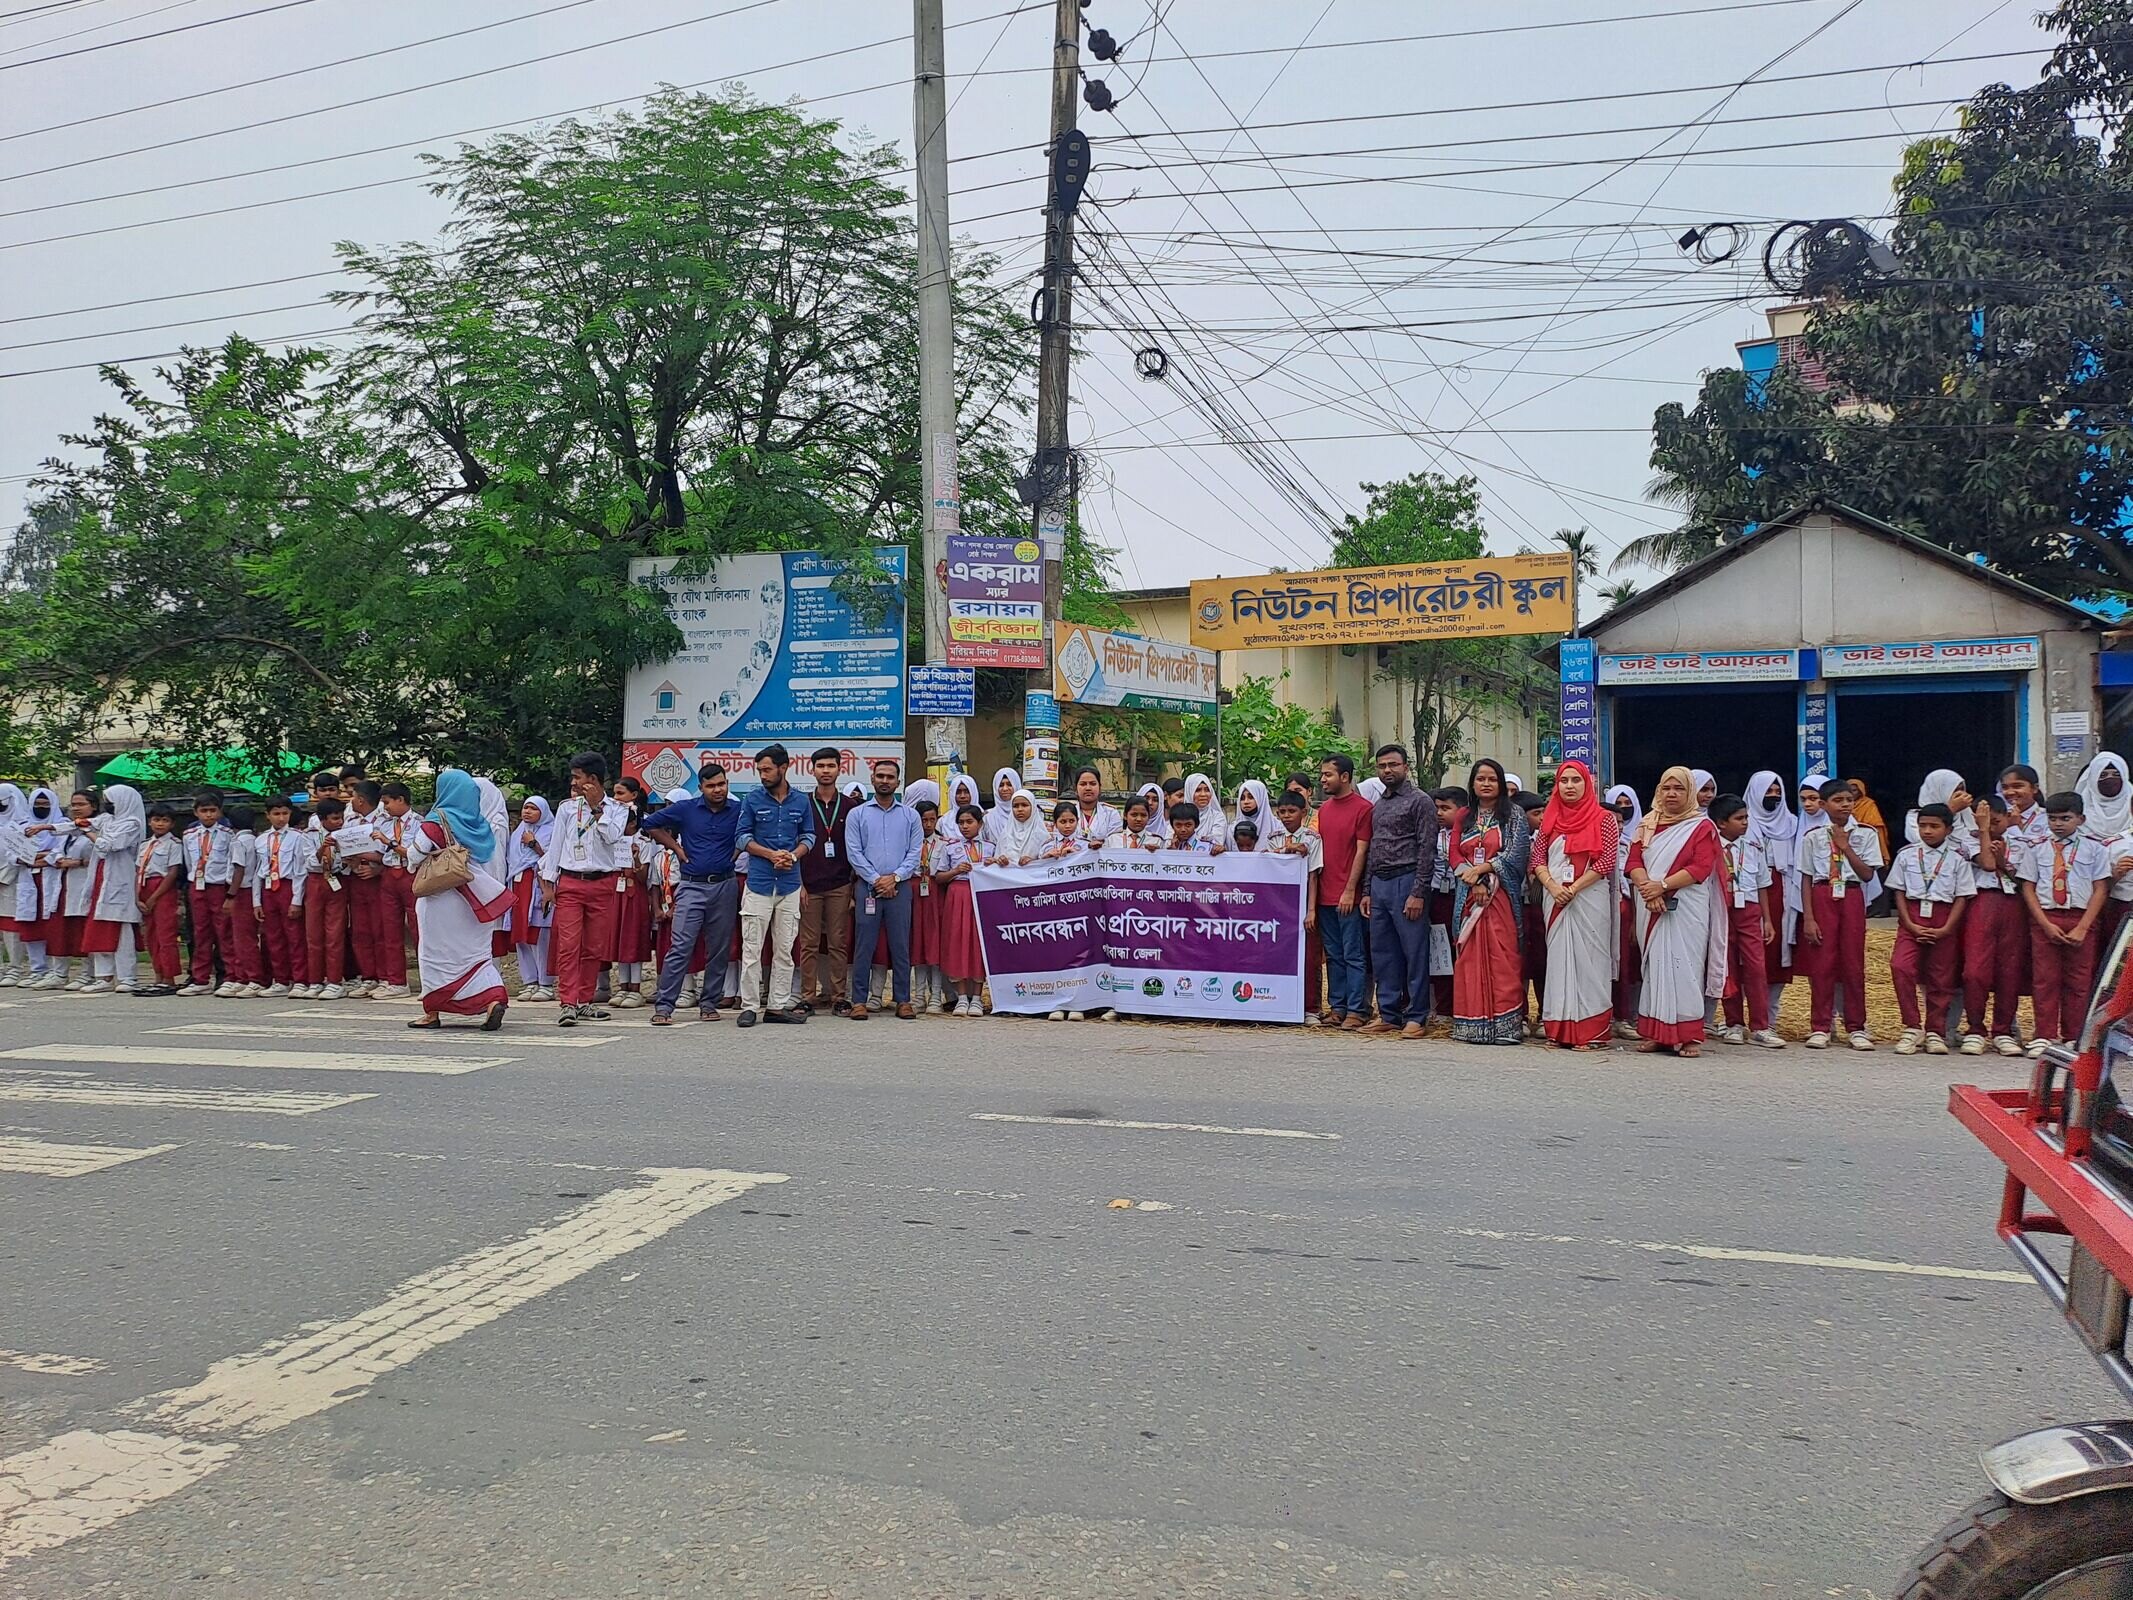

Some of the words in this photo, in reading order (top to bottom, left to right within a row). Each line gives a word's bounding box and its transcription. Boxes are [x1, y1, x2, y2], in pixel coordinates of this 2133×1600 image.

[792, 557, 817, 572] গ্রামীণ
[949, 562, 1040, 586] একরাম
[681, 589, 701, 603] যৌথ
[704, 587, 751, 602] মালিকানায়
[986, 587, 1009, 598] স্যার
[1230, 588, 1339, 624] নিউটন
[1346, 572, 1506, 618] প্রিপারেটরী
[1508, 576, 1569, 617] স্কুল
[682, 609, 707, 621] ব্যাংক
[953, 602, 1037, 617] রসায়ন
[952, 618, 1038, 636] জীববিজ্ঞান
[1843, 646, 1885, 662] ভাই
[1892, 644, 1935, 660] ভাই
[1941, 642, 2032, 657] আয়রন
[1103, 636, 1144, 680] নিউটন
[1146, 644, 1199, 686] প্রিপারেটরী
[1563, 657, 1588, 668] ২৬তম
[1618, 655, 1659, 670] ভাই
[1663, 654, 1701, 669] ভাই
[1707, 654, 1789, 669] আয়রন
[911, 668, 930, 680] জমি
[1568, 670, 1584, 681] বর্ষে
[1565, 685, 1587, 695] শিশু
[1564, 700, 1588, 711] শ্রেণি
[642, 718, 666, 729] গ্রামীণ
[666, 718, 688, 729] ব্যাংক
[745, 718, 765, 731] গ্রামীণ
[766, 719, 793, 732] ব্যাংকের
[794, 719, 811, 730] সকল
[813, 719, 832, 730] প্রকার
[1563, 717, 1591, 727] থেকে
[1565, 733, 1588, 742] নবম
[1565, 747, 1589, 758] শ্রেণি
[1047, 867, 1064, 878] শিশু
[1067, 862, 1095, 877] সুরক্ষা
[1097, 859, 1128, 872] নিশ্চিত
[1161, 864, 1193, 875] করতে
[1195, 865, 1215, 875] হবে
[1014, 894, 1030, 909] শিশু
[1032, 892, 1057, 907] রামিসা
[1103, 885, 1134, 901] প্রতিবাদ
[1136, 889, 1154, 902] এবং
[1157, 887, 1192, 902] আসামীর
[1222, 888, 1255, 904] দাবীতে
[996, 916, 1089, 944] মানববন্ধন
[1108, 908, 1190, 940] প্রতিবাদ
[1193, 916, 1280, 943] সমাবেশ
[1133, 948, 1162, 961] জেলা
[1029, 981, 1055, 991] Happy
[1056, 977, 1088, 988] Dreams
